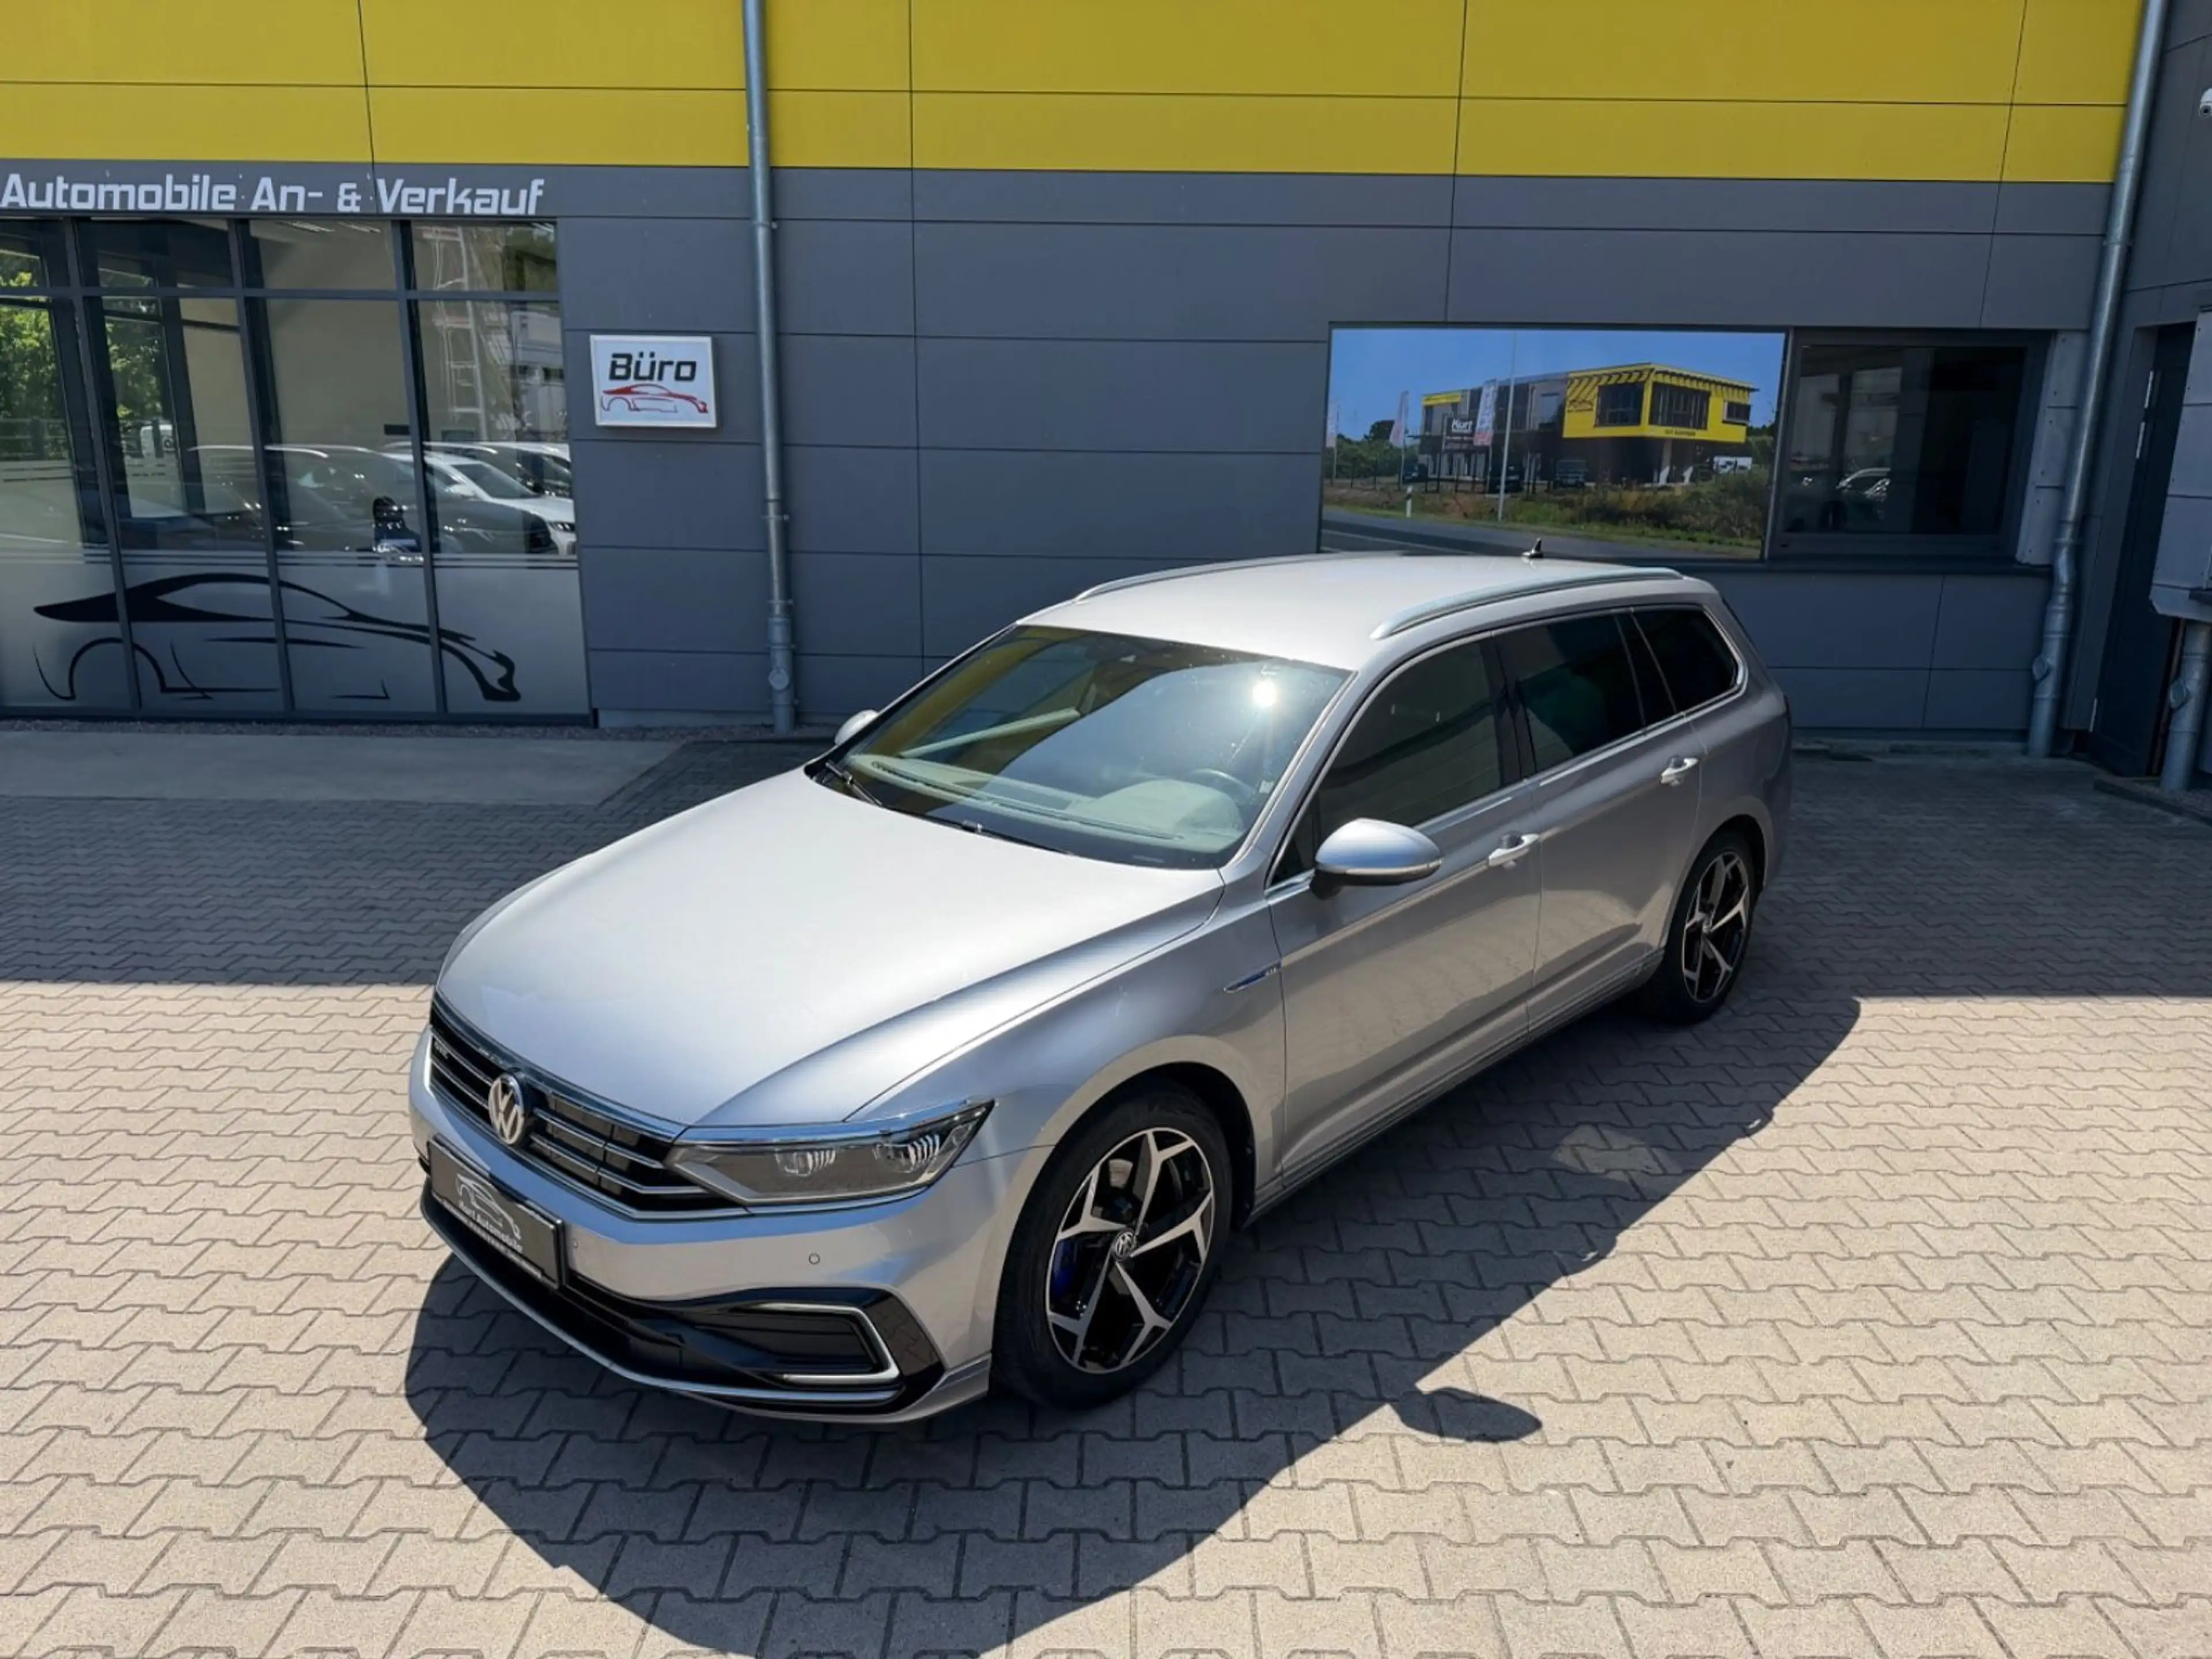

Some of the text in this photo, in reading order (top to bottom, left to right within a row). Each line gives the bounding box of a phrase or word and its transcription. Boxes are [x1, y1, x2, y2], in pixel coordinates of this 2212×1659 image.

[0, 173, 544, 215] Automobile An- & Verkauf
[609, 351, 696, 381] Büro
